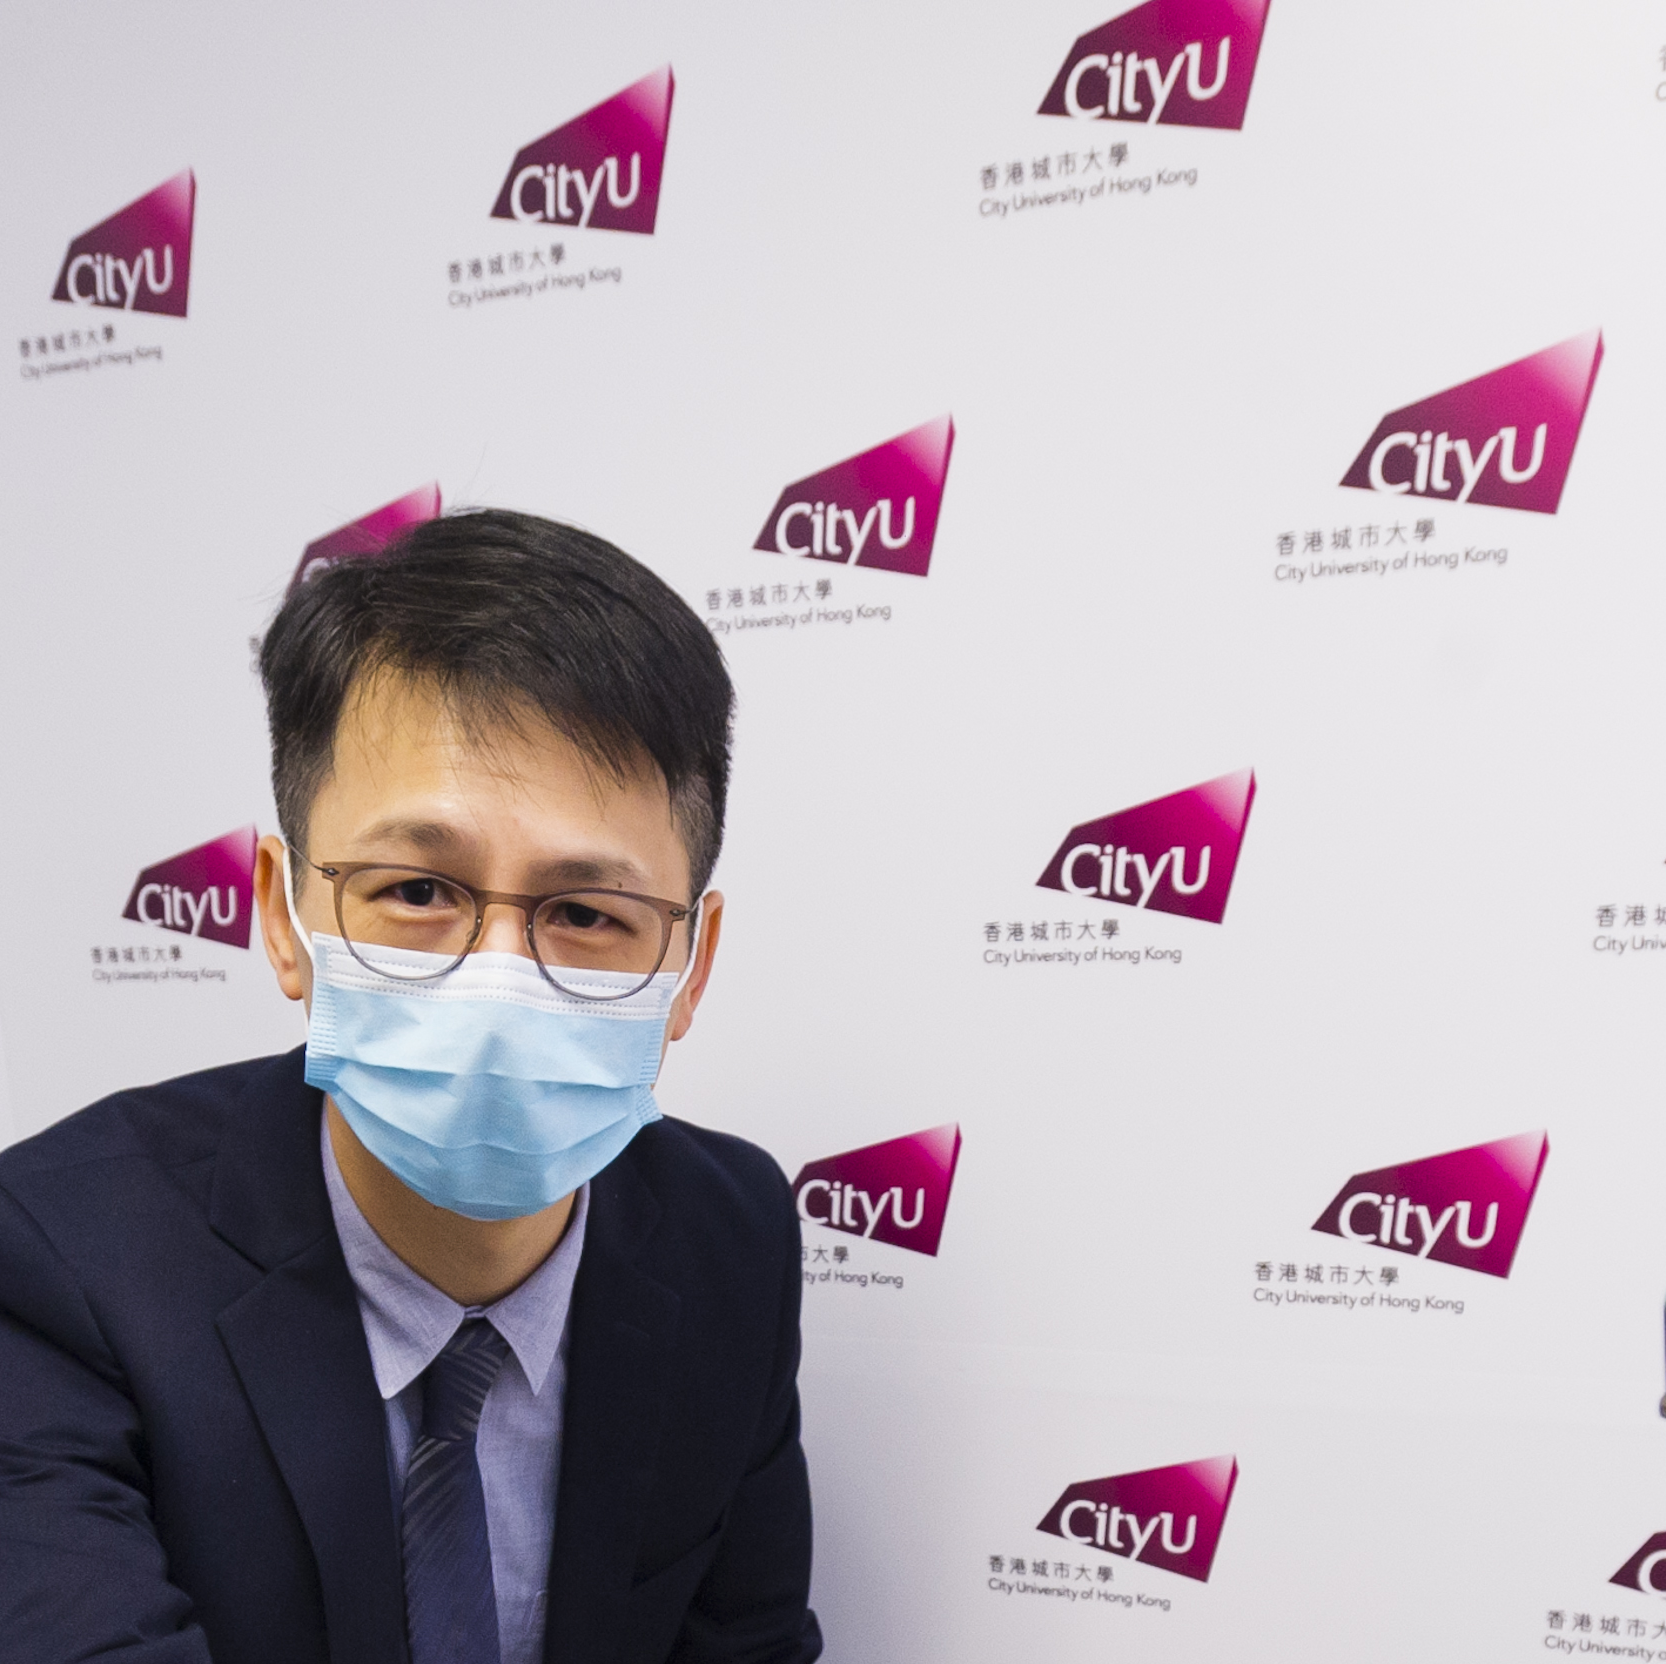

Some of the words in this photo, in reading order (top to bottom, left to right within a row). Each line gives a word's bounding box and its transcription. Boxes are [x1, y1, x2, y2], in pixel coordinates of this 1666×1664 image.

[1065, 36, 1231, 126] CityU
[978, 141, 1130, 191] 香港城市大學
[511, 152, 641, 229] CityU
[978, 198, 1010, 219] City
[1012, 184, 1087, 212] University
[1089, 177, 1107, 198] of
[1109, 176, 1152, 195] Hong
[1156, 168, 1198, 187] Kong
[67, 243, 173, 312] CityU
[1371, 423, 1548, 504] CityU
[777, 497, 914, 567] CityU
[1275, 517, 1436, 557] 香港城市大學
[1273, 563, 1308, 585] City
[1309, 556, 1390, 579] University
[1391, 551, 1411, 571] of
[1413, 551, 1459, 571] Hong
[1463, 546, 1509, 567] Kong
[703, 577, 834, 612] 香港城市大學
[733, 611, 798, 632] University
[799, 607, 814, 626] of
[816, 607, 853, 626] Hong
[856, 604, 892, 622] Kong
[1061, 843, 1212, 909] CityU
[137, 883, 236, 938] CityU
[983, 918, 1120, 943] 香港城市大學
[982, 948, 1012, 968] City
[1013, 947, 1082, 967] University
[1083, 945, 1099, 962] of
[1101, 946, 1141, 966] Hong
[1144, 945, 1183, 965] Kong
[1591, 934, 1629, 956] City
[796, 1178, 926, 1239] CityU
[1339, 1191, 1500, 1260] CityU
[818, 1268, 833, 1282] of
[834, 1269, 868, 1288] Hong
[870, 1271, 904, 1290] Kong
[1253, 1260, 1400, 1288] 香港城市大學
[1252, 1287, 1284, 1307] City
[1285, 1289, 1358, 1310] University
[1359, 1291, 1377, 1307] of
[1379, 1293, 1421, 1314] Hong
[1424, 1295, 1465, 1315] Kong
[1060, 1499, 1197, 1562] CityU
[988, 1554, 1114, 1584] 香港城市大學
[987, 1577, 1015, 1596] City
[1016, 1580, 1079, 1602] University
[1079, 1586, 1095, 1601] of
[1096, 1588, 1133, 1608] Hong
[1136, 1592, 1171, 1612] Kong
[1544, 1634, 1577, 1655] City
[1578, 1638, 1656, 1663] University
